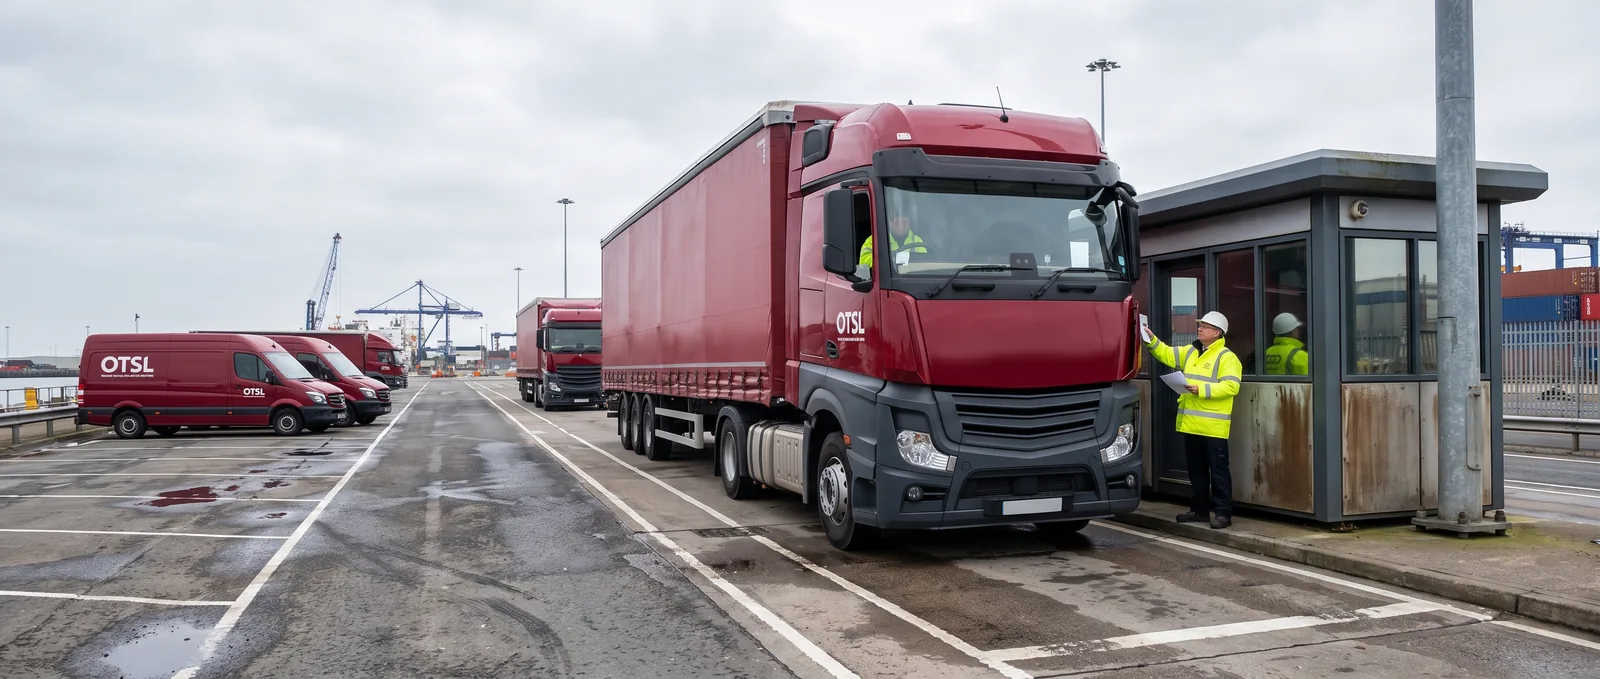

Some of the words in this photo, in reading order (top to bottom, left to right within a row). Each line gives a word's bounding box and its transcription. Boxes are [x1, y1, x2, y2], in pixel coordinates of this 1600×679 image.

[836, 311, 865, 334] OTSL
[101, 356, 154, 373] OTSL
[243, 387, 265, 396] OTSL
